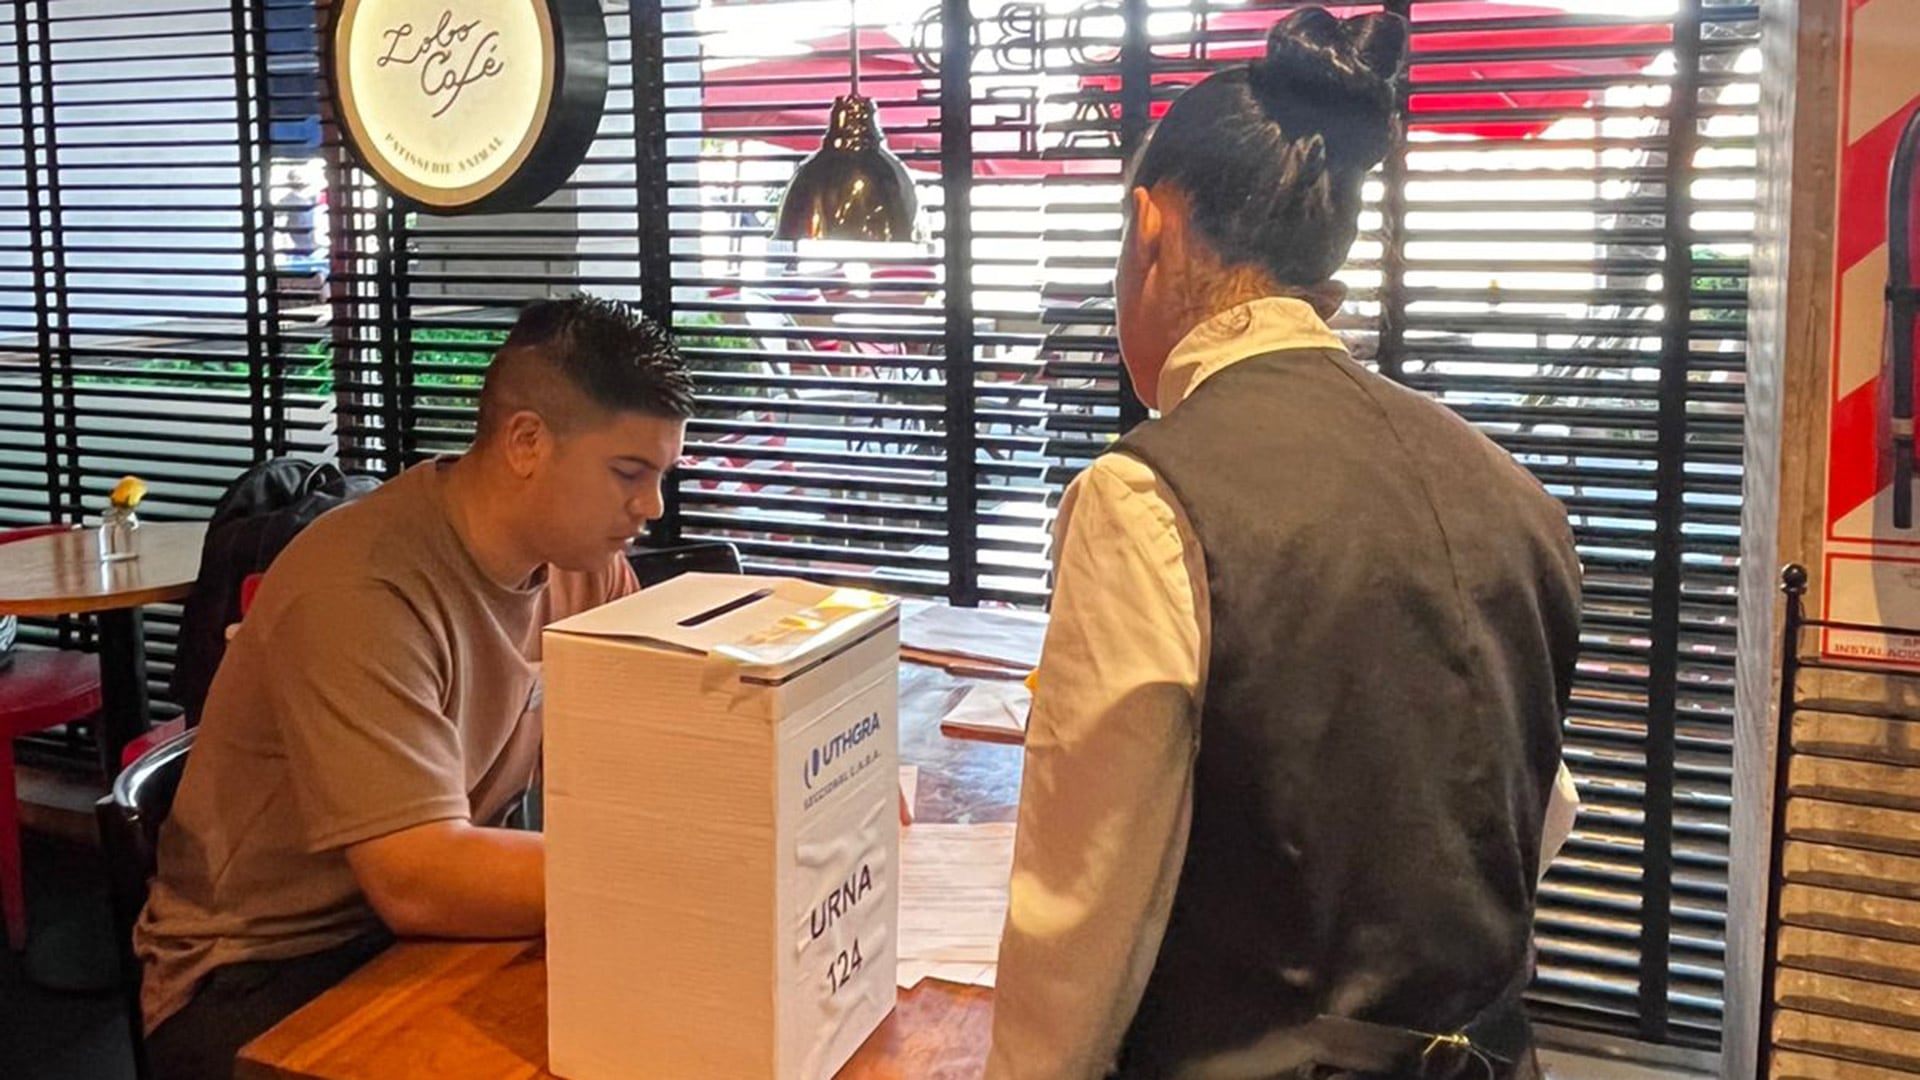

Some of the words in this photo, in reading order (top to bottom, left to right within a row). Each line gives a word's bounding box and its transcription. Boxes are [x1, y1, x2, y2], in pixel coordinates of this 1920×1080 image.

[377, 10, 481, 67] Lobo
[421, 32, 504, 118] Café
[385, 132, 451, 174] PATISSERIE
[822, 712, 880, 766] UTHGRA
[810, 864, 872, 940] URNA
[827, 938, 863, 996] 124
